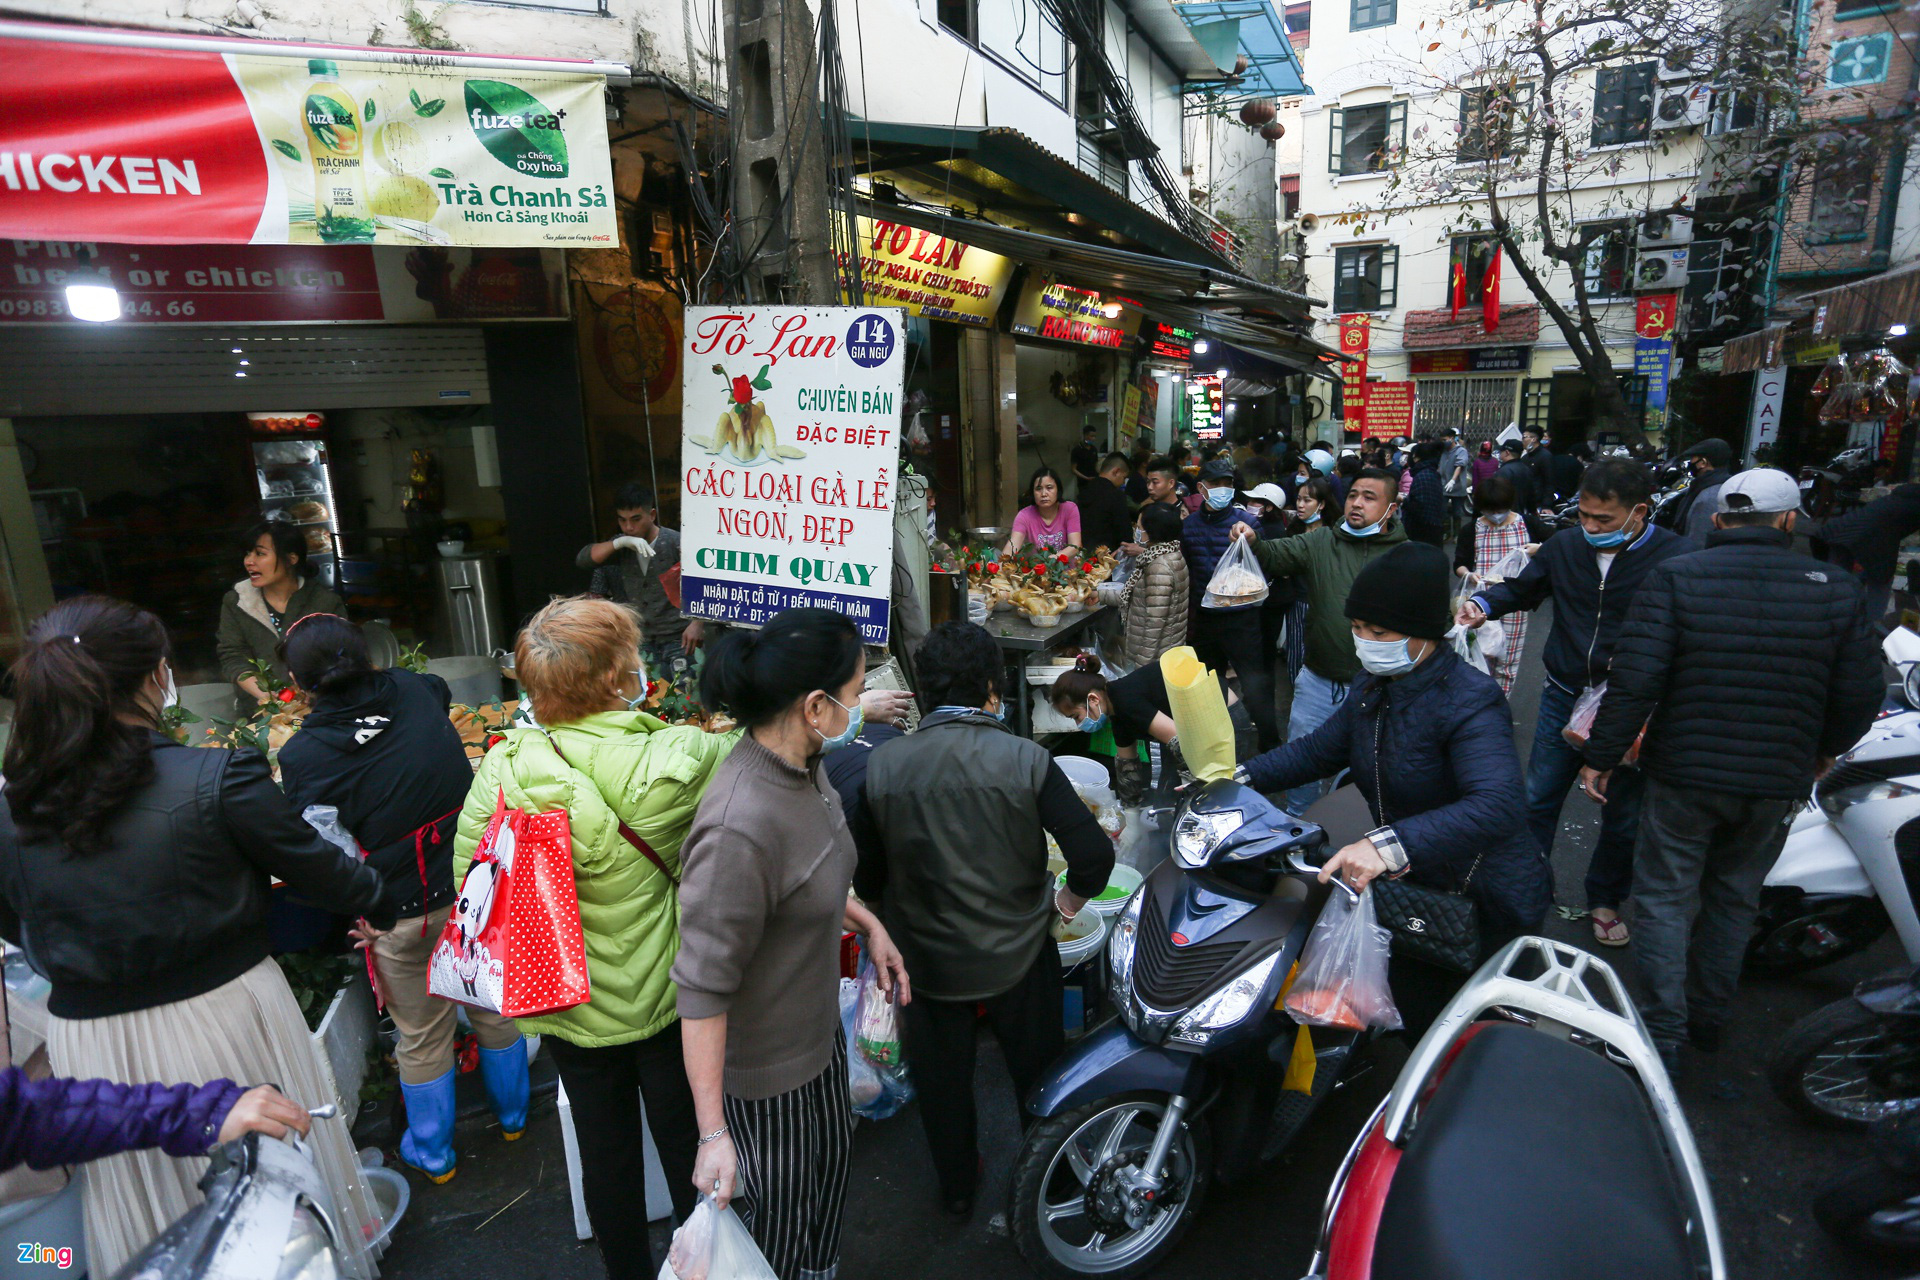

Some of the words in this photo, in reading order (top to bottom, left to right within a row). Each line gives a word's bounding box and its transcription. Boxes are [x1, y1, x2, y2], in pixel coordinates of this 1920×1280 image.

[316, 155, 331, 167] TRÀ
[332, 157, 360, 168] CHANH
[517, 160, 540, 174] Oxy
[542, 160, 564, 173] hoá
[528, 151, 553, 162] Chống
[438, 183, 484, 206] Trà
[489, 185, 572, 208] Chanh
[578, 185, 608, 208] Sả
[464, 210, 493, 223] Hơn
[496, 210, 514, 223] Cả
[516, 210, 549, 227] Sảng
[551, 211, 589, 224] Khoái
[13, 264, 112, 286] bef
[128, 269, 170, 287] or
[184, 266, 346, 287] chicken
[883, 262, 924, 284] NGAN
[922, 271, 954, 290] CHIM
[691, 313, 756, 356] Tố
[752, 314, 845, 367] Lan
[854, 319, 888, 344] 14
[851, 346, 866, 360] GIA
[869, 345, 889, 360] NGƯ
[797, 384, 858, 413] CHUYÊN
[862, 385, 893, 415] BÁN
[797, 422, 837, 446] ĐẶC
[844, 425, 891, 449] BIỆT
[686, 462, 736, 498] CÁC
[743, 470, 803, 509] LOẠI
[811, 470, 849, 509] GÀ
[857, 467, 890, 512] LỄ
[717, 507, 794, 545] NGON,
[803, 514, 854, 553] ĐẸP
[696, 547, 780, 576] CHIM
[789, 556, 878, 587] QUAY
[690, 599, 705, 615] GIÁ
[708, 602, 726, 618] HỢP
[728, 603, 741, 619] LÝ
[750, 608, 766, 622] ĐT:
[703, 584, 728, 601] NHẬN
[731, 587, 750, 606] ĐẶT,
[751, 585, 765, 605] CỖ
[767, 588, 780, 606] TỪ
[783, 595, 787, 607] 1
[791, 592, 811, 608] ĐẾN
[813, 595, 843, 613] NHIỀU
[846, 600, 871, 618] MÂM
[860, 623, 884, 639] 1977
